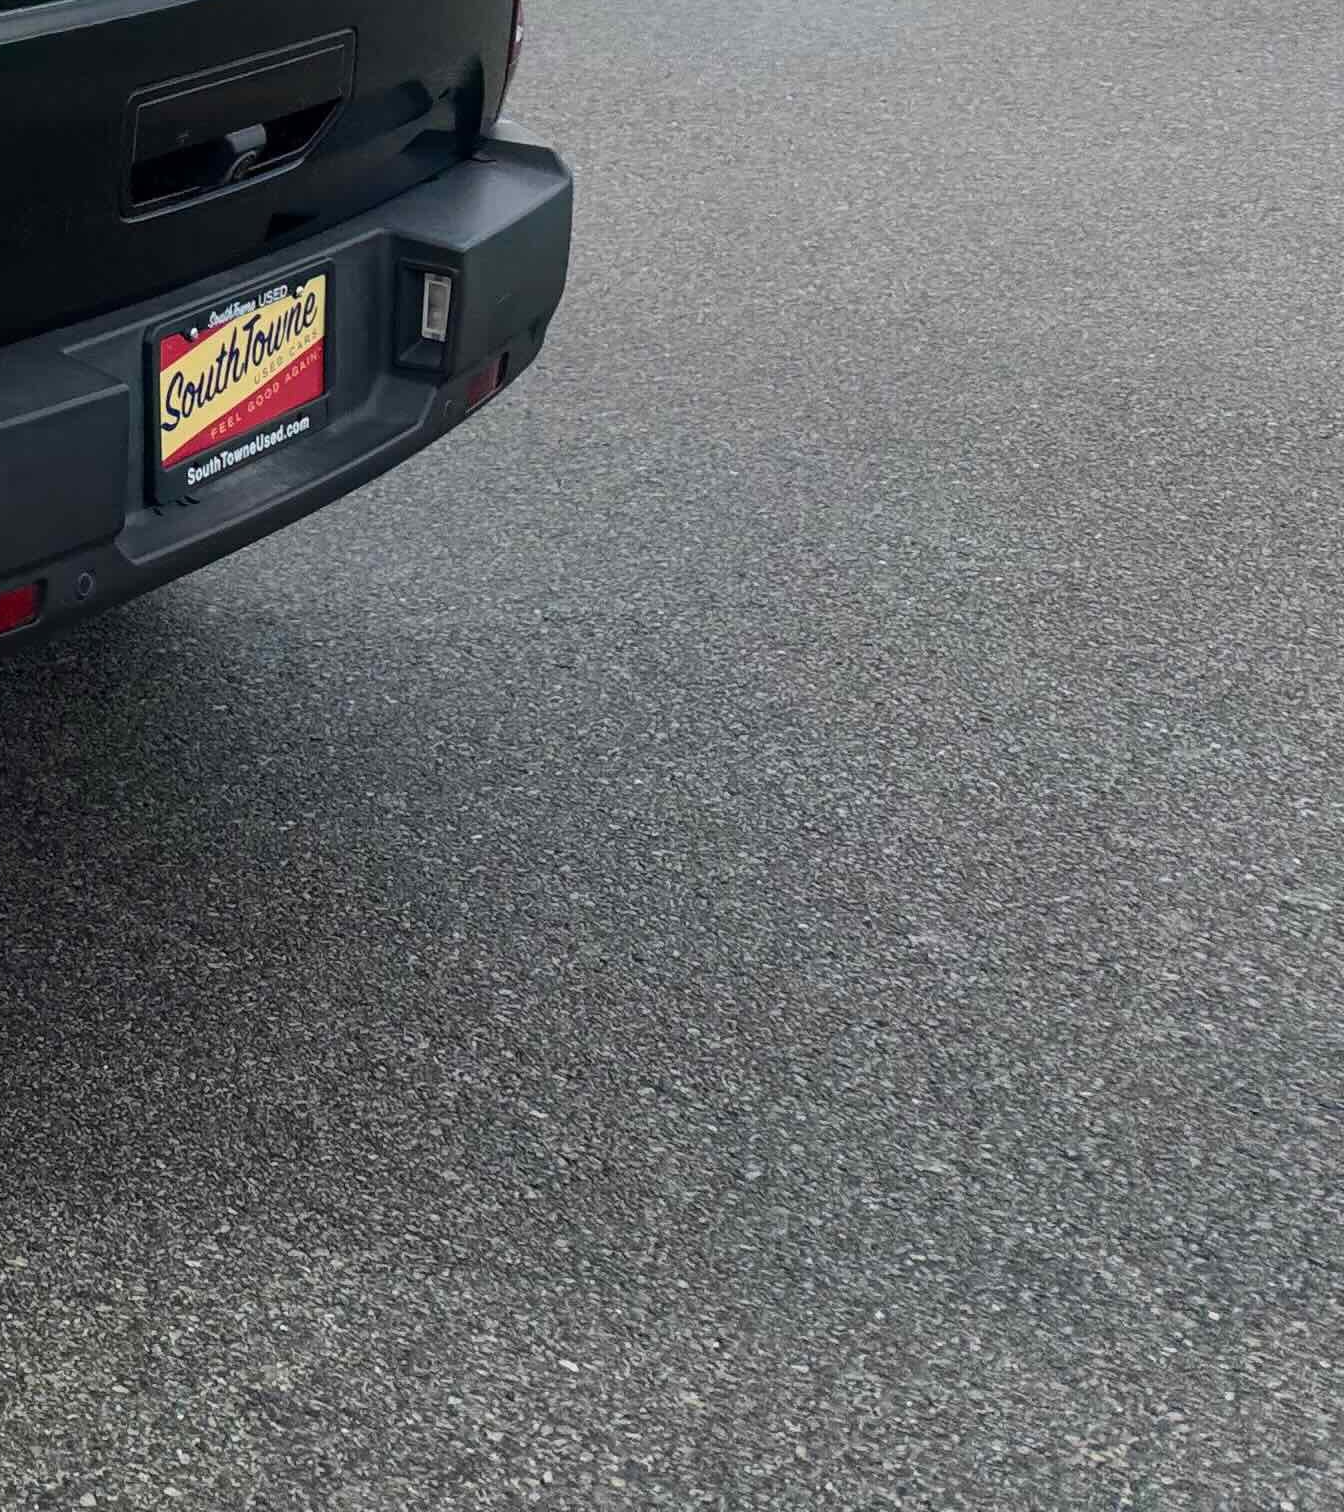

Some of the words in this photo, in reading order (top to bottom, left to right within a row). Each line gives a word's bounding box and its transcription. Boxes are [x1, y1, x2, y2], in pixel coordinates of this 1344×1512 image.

[258, 285, 288, 307] USED
[161, 291, 318, 432] SouthTowne
[254, 355, 283, 385] USED
[289, 330, 318, 356] CARS
[211, 413, 242, 440] FEEL
[247, 381, 280, 413] GOOD
[187, 415, 310, 486] SouthTowneUsed.com
